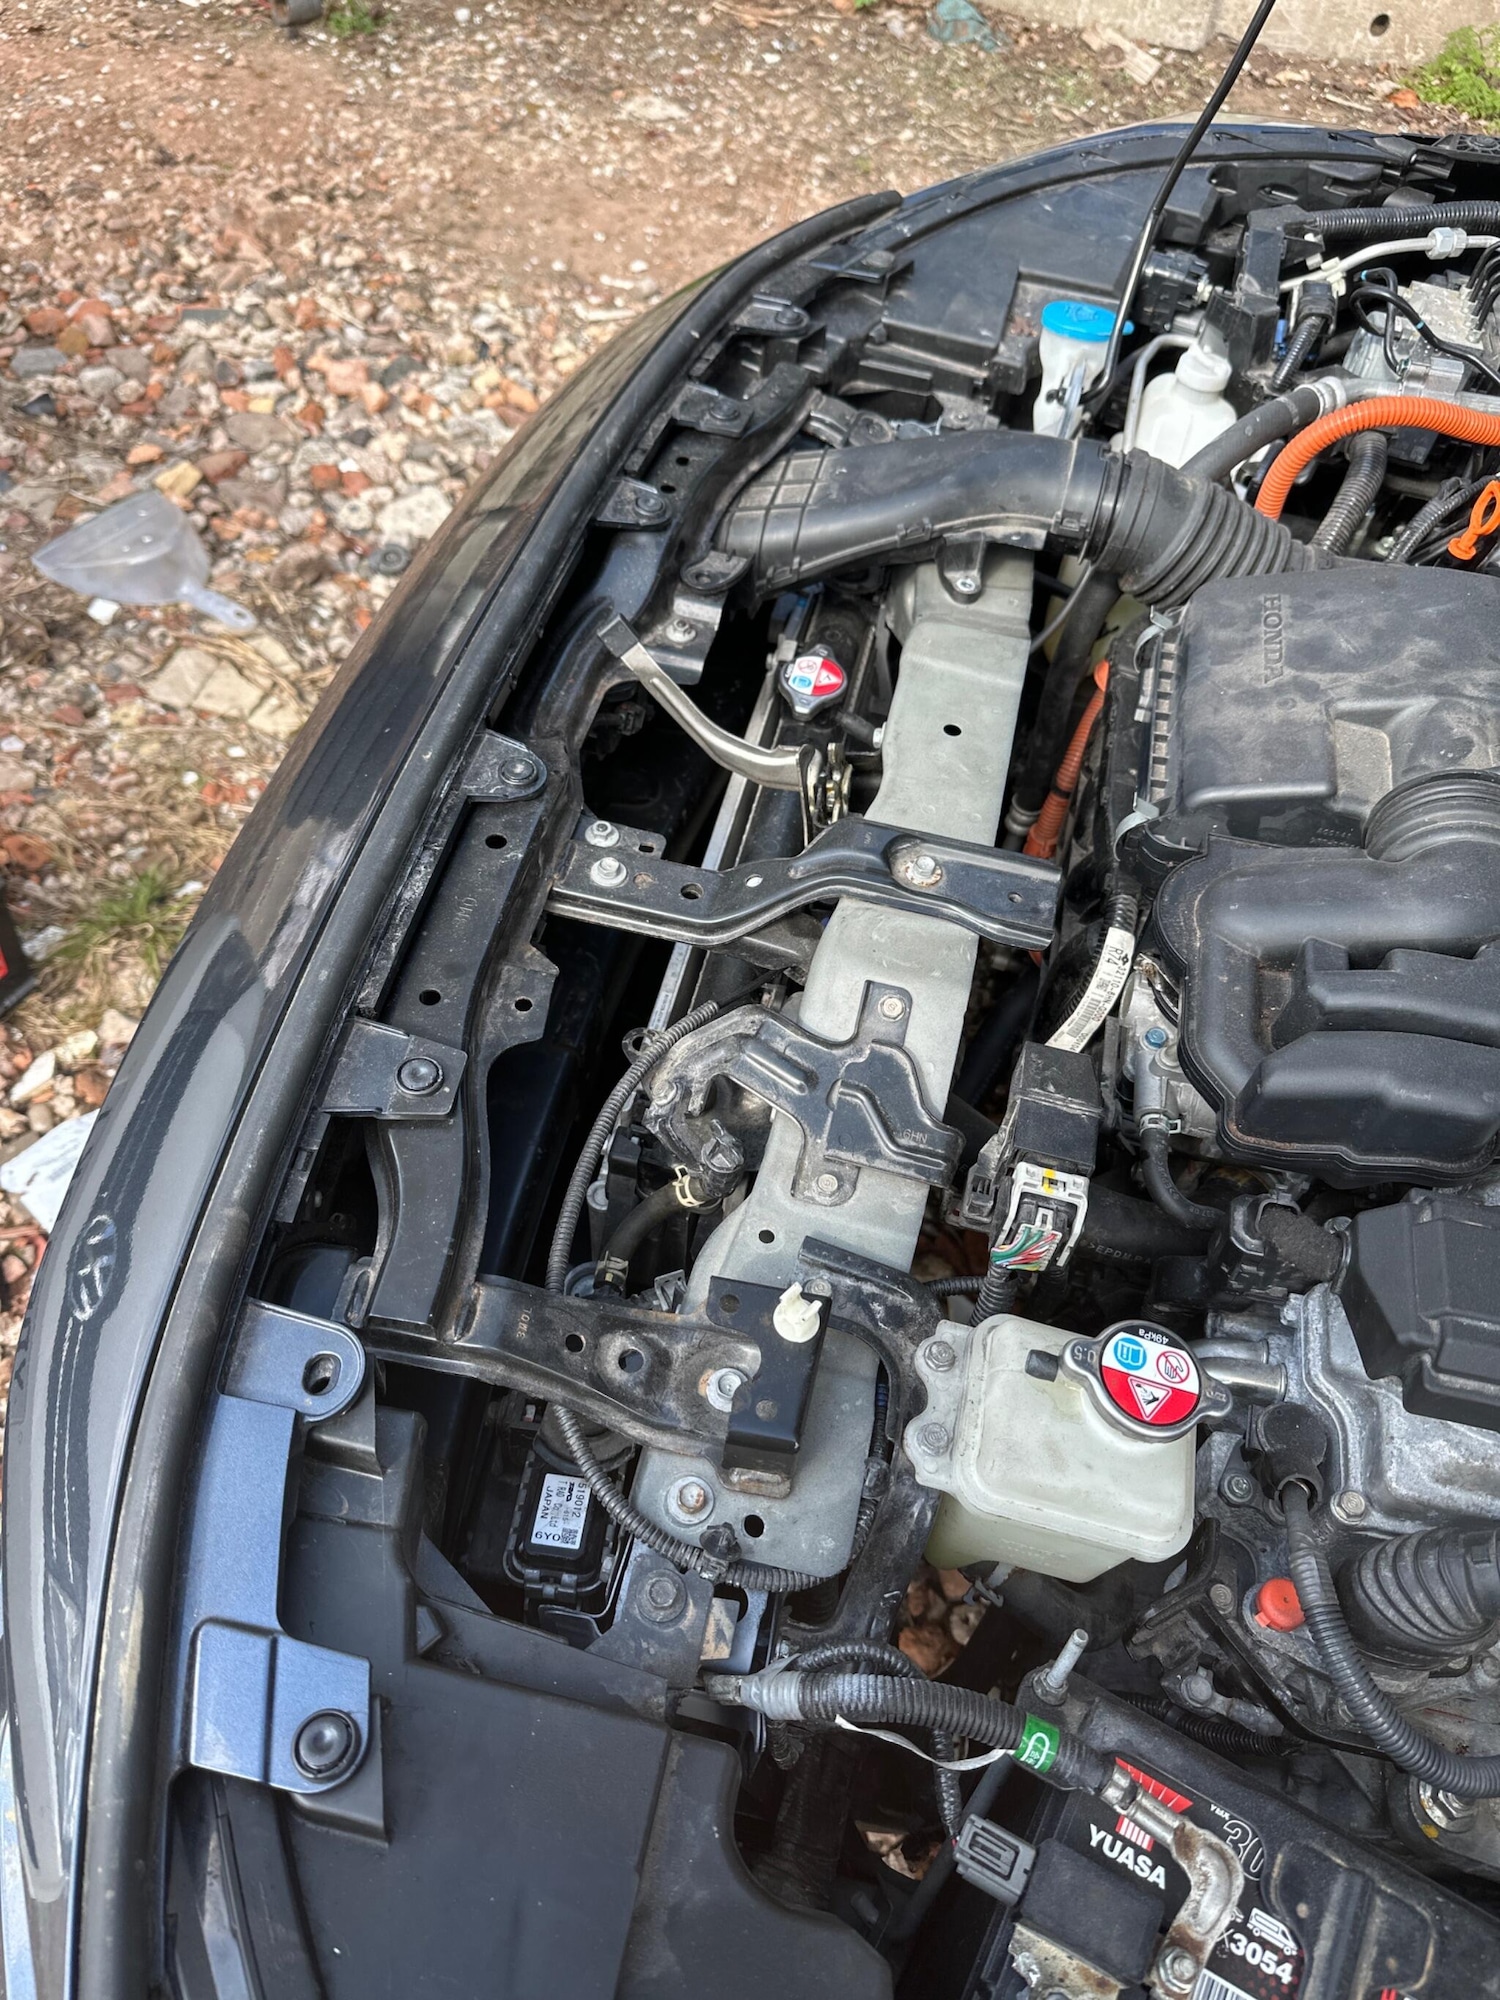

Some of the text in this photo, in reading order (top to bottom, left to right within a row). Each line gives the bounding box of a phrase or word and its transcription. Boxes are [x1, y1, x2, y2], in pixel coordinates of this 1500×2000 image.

[1263, 594, 1284, 684] HONDA
[1106, 944, 1124, 966] R74
[903, 1128, 928, 1144] 6HN
[1138, 1328, 1169, 1345] 49kPa
[541, 1486, 554, 1519] JAPAN
[571, 1482, 587, 1518] 519012
[1088, 1823, 1167, 1890] YUASA
